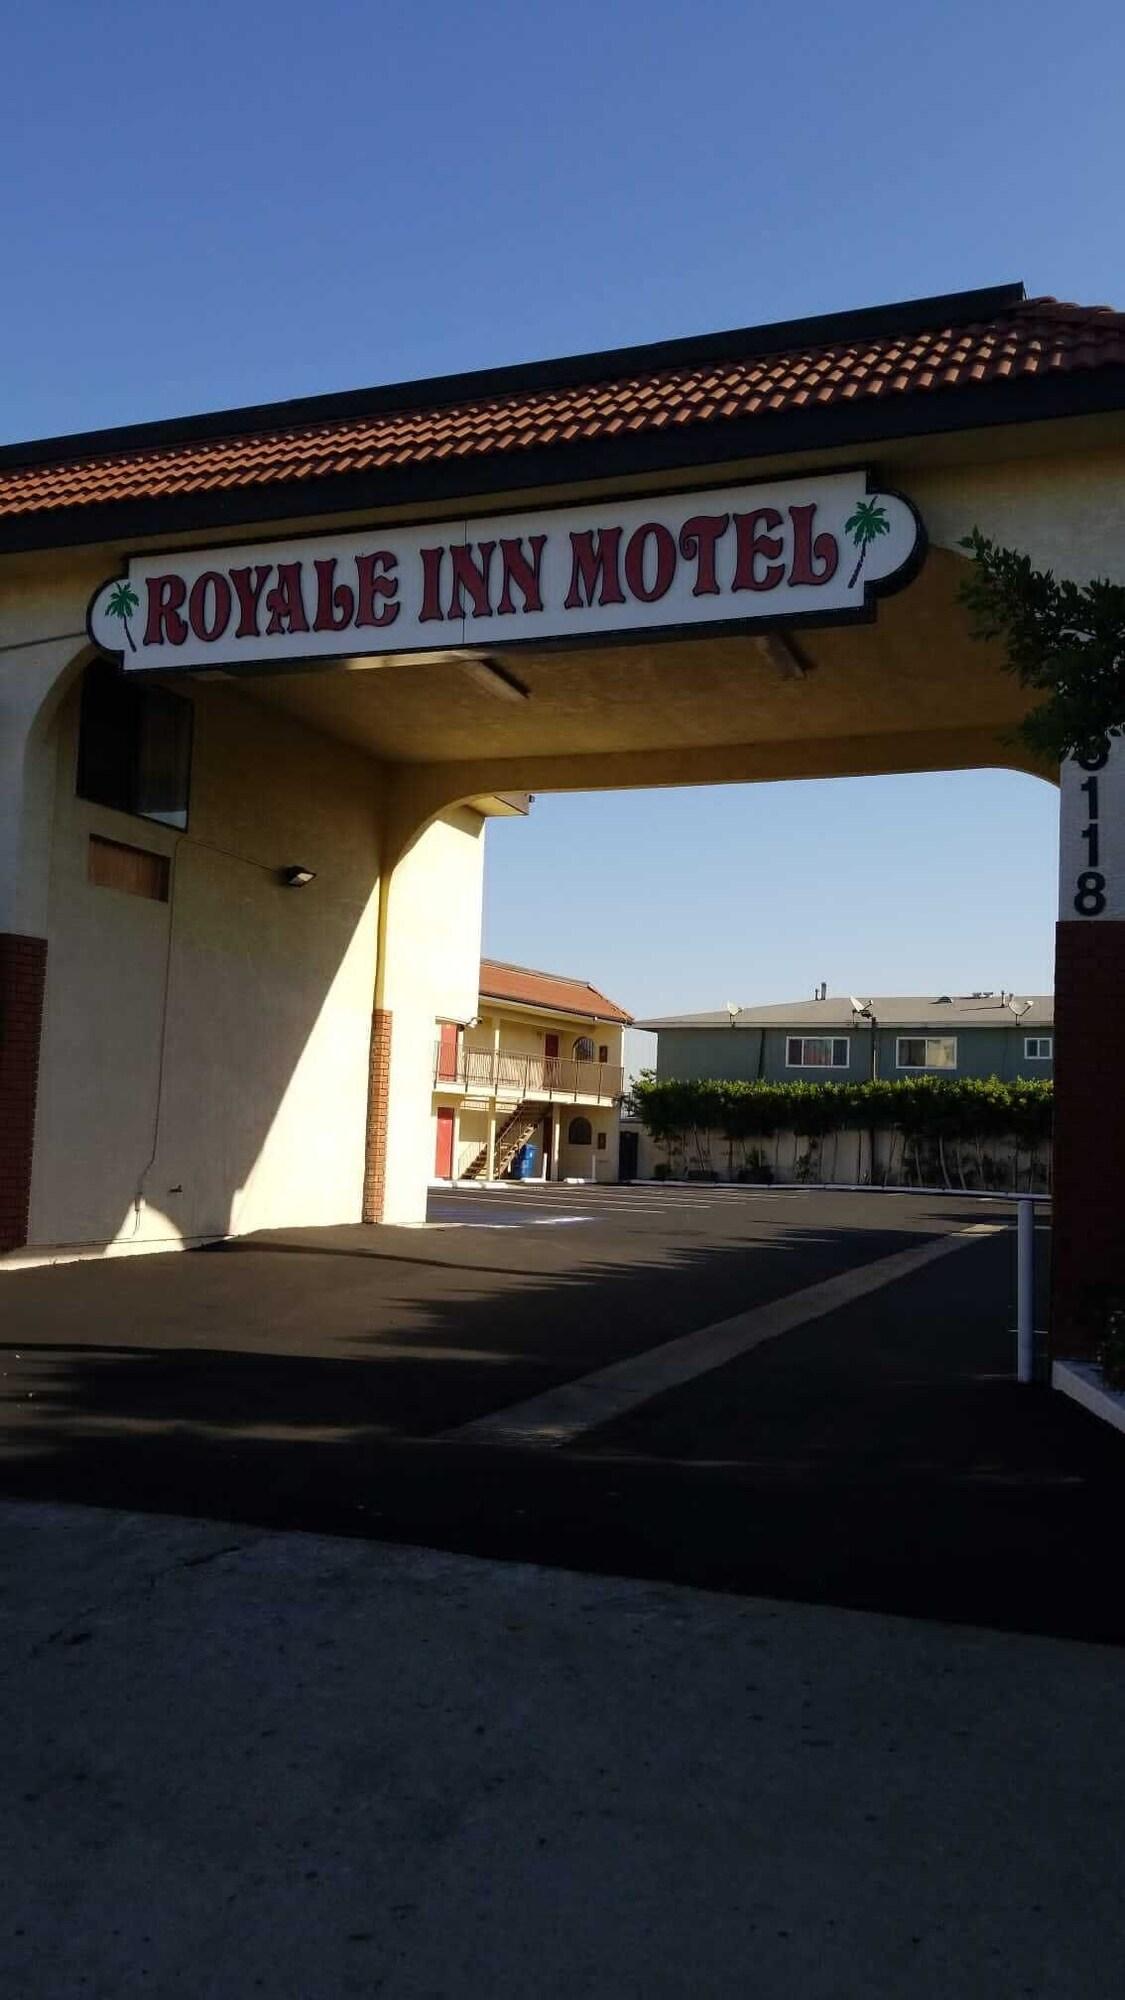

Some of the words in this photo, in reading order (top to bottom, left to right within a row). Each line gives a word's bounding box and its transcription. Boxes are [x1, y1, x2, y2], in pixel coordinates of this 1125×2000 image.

[143, 551, 399, 646] ROYALE
[419, 534, 548, 622] INN
[564, 503, 839, 609] MOTEL
